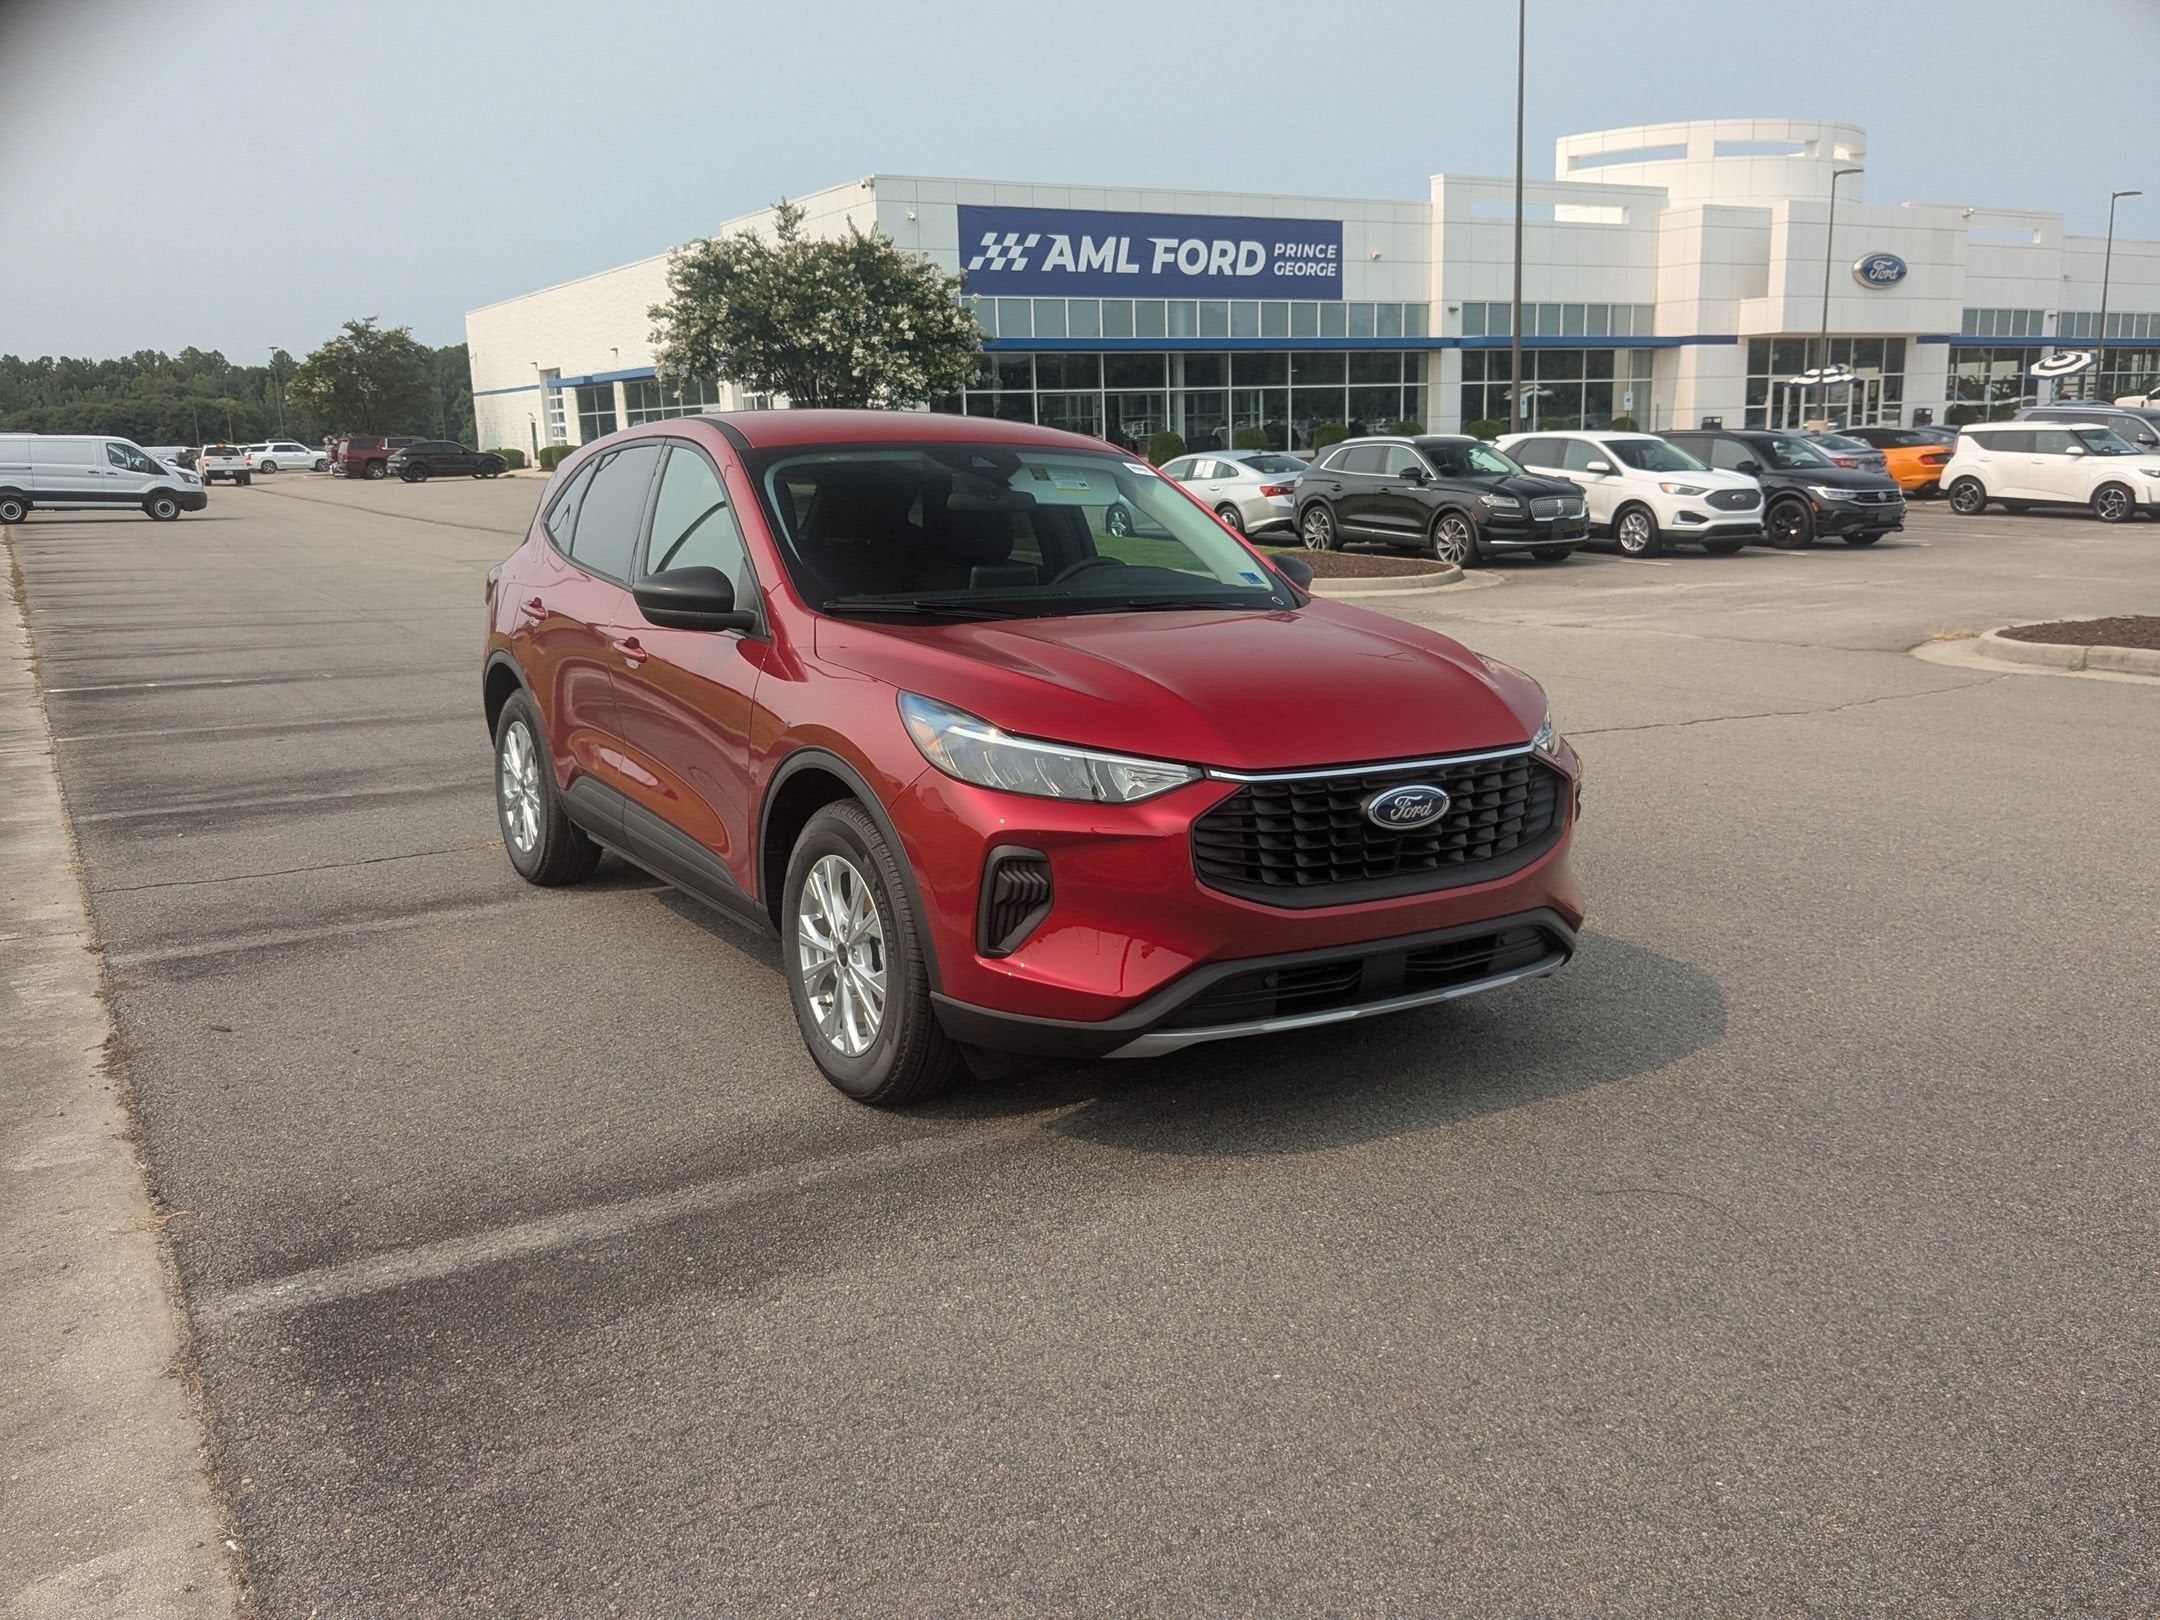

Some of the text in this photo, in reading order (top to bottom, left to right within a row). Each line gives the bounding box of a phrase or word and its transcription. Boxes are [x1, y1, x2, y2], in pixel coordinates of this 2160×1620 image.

[1041, 234, 1266, 276] AML FORD
[1273, 243, 1338, 259] PRINCE
[1273, 261, 1338, 277] GEORGE
[1869, 259, 1900, 280] Ford
[1390, 795, 1434, 821] Ford
